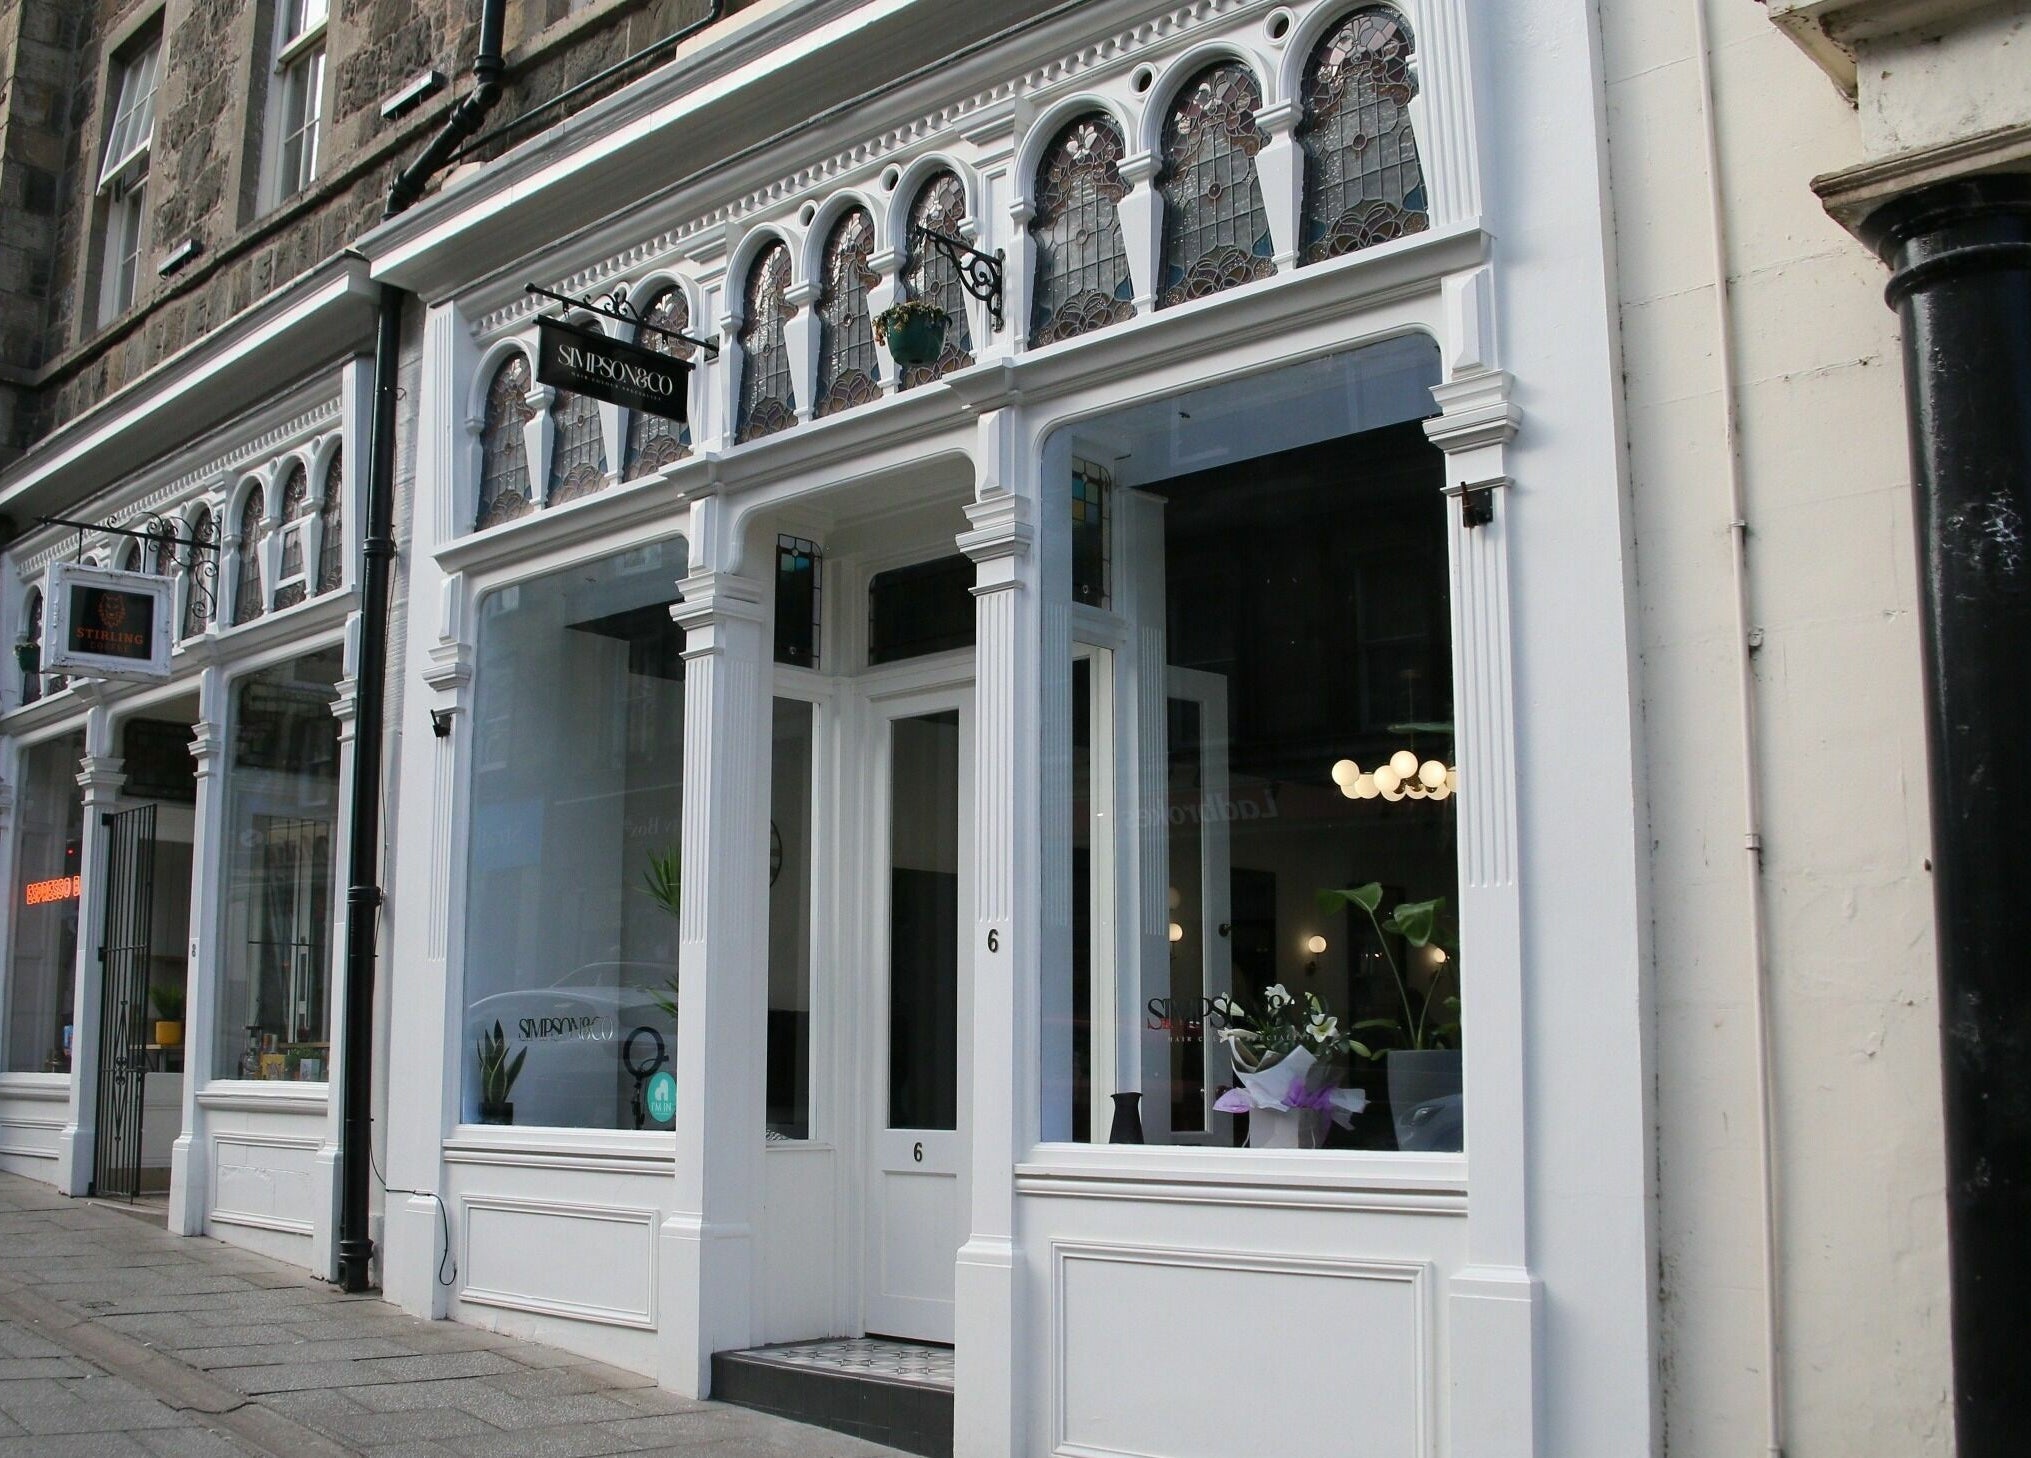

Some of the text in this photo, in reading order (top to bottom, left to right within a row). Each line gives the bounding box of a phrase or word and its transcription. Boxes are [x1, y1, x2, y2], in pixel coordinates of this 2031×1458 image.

[558, 344, 673, 396] SIMPSON&CO
[76, 628, 143, 644] STIRLING
[27, 877, 71, 904] ESPRESSO
[987, 928, 999, 953] 6
[518, 1015, 614, 1042] SIMPSON&CO
[663, 1102, 672, 1113] IN
[913, 1141, 923, 1162] 6
